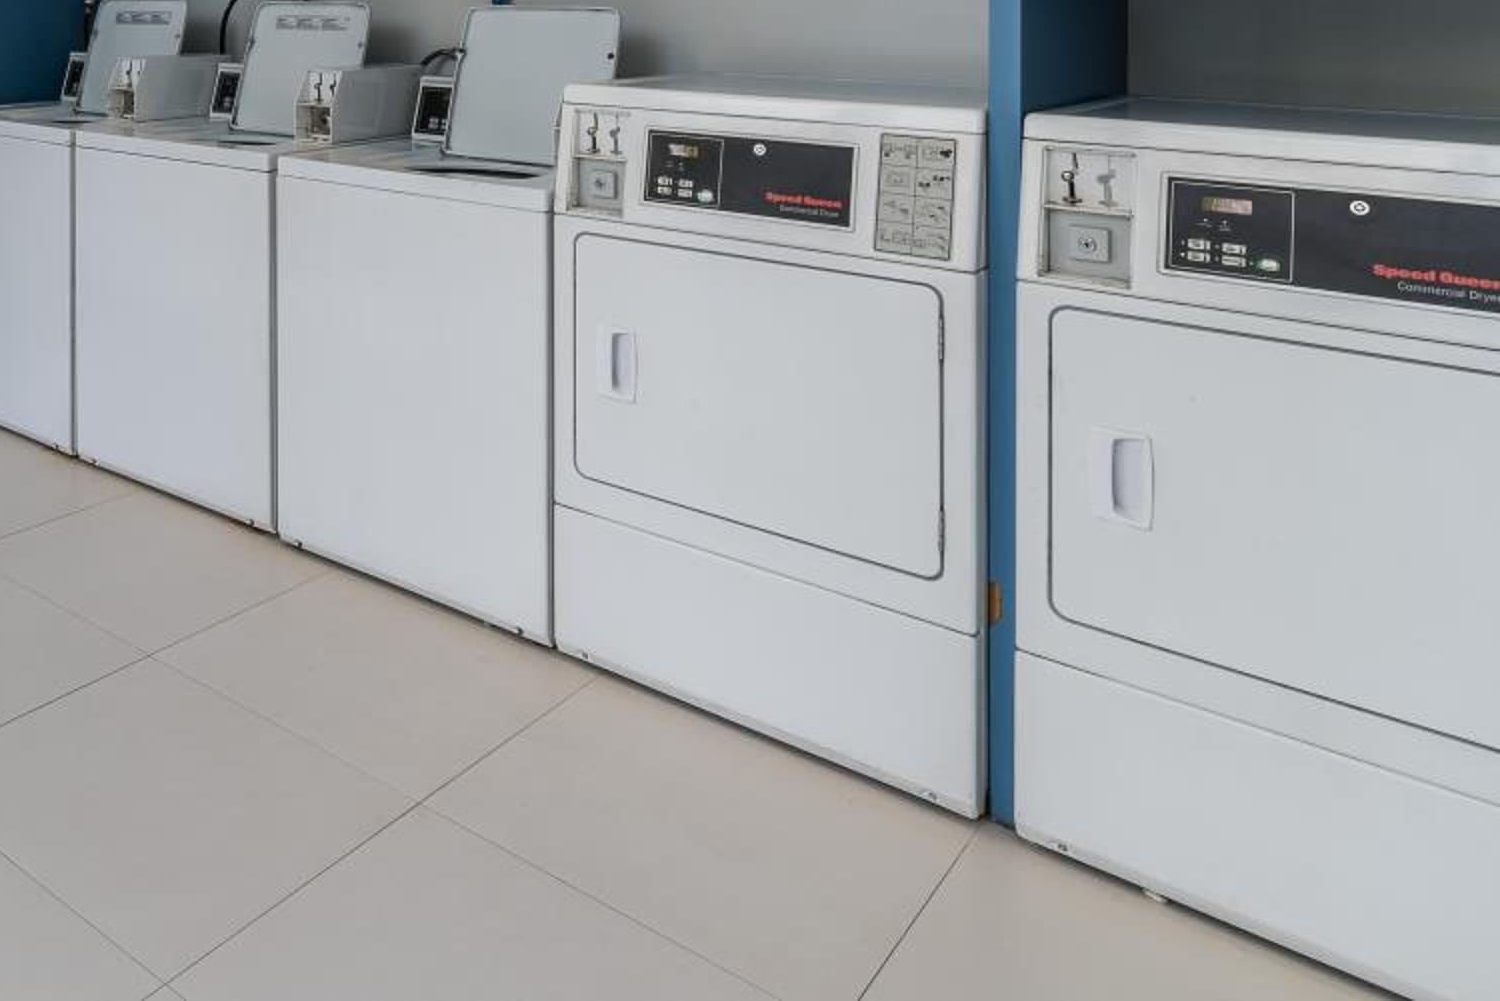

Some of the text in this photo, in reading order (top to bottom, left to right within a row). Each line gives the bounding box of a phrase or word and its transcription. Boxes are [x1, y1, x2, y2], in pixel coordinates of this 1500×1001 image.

[764, 190, 843, 210] Speed Queen
[1373, 264, 1437, 281] Speed
[1397, 280, 1467, 298] Commercial
